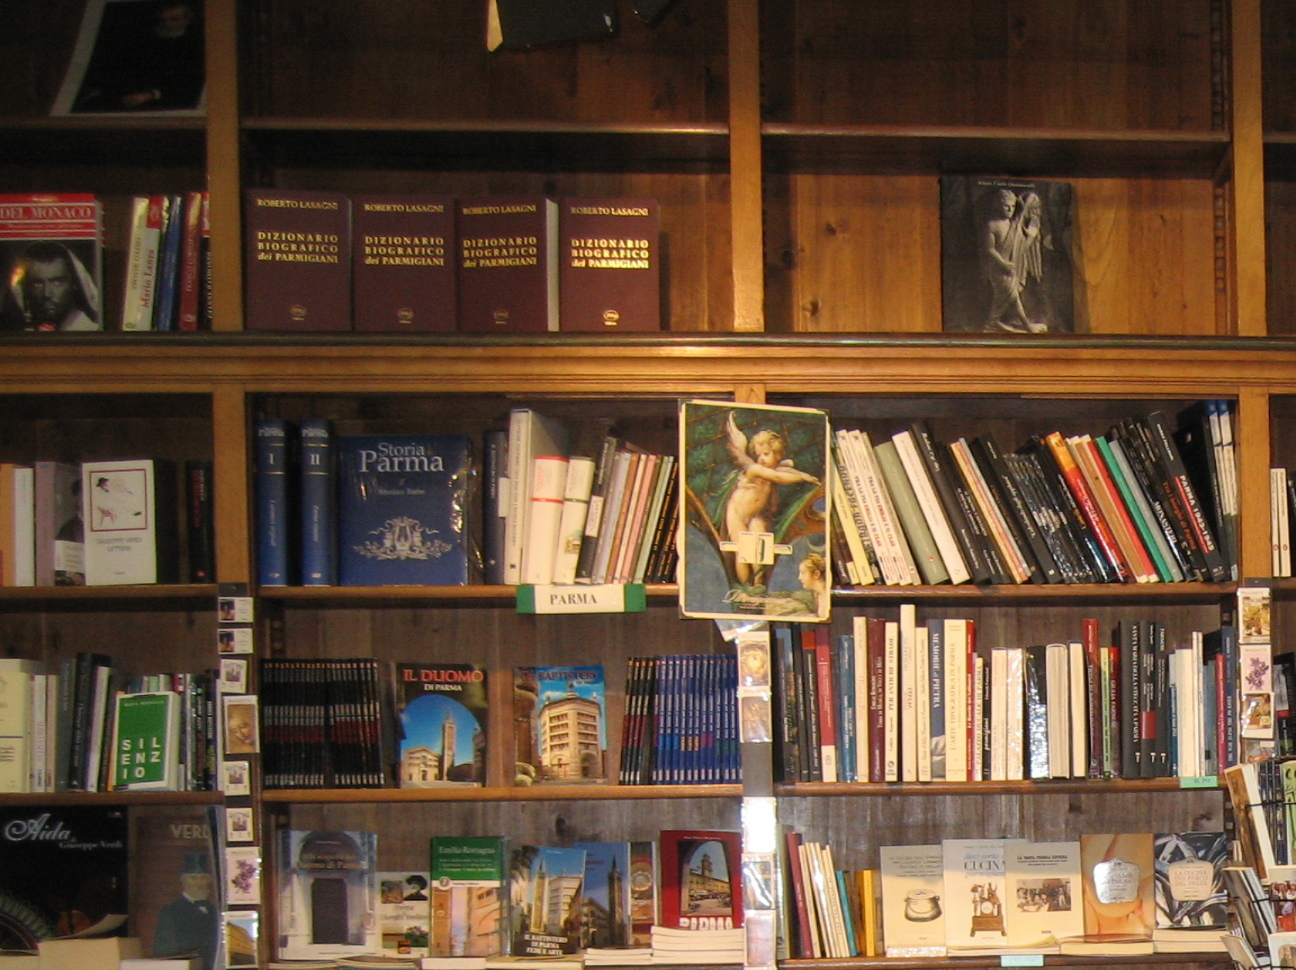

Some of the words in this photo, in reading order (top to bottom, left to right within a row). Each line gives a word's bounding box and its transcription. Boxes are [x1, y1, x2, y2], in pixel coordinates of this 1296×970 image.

[258, 199, 298, 209] ROBERTO
[299, 201, 338, 210] LASAGNI
[364, 204, 404, 212] ROBERTO
[406, 205, 444, 213] LASAGNI
[463, 206, 500, 215] ROBERTO
[501, 205, 536, 213] LASAGNI
[1, 208, 24, 219] DEL
[32, 207, 91, 219] MONACO
[571, 207, 610, 215] ROBERTO
[611, 208, 649, 216] LASAGNI
[258, 231, 338, 243] DIZIONARIO
[365, 236, 444, 245] DIZIONARIO
[463, 237, 537, 248] DIZIONARIO
[258, 243, 338, 253] BIOGRAFICO
[571, 239, 649, 248] DIZIONARIO
[365, 246, 444, 256] BIOGRAFICO
[463, 247, 537, 258] BIOGRAFICO
[571, 249, 649, 258] BIOGRAFICO
[258, 252, 272, 261] dei
[275, 253, 338, 264] PARMIGIANI
[365, 257, 379, 265] dei
[382, 257, 444, 266] PARMIGIANI
[463, 259, 477, 268] dei
[479, 257, 537, 267] PARMIGIANI
[571, 259, 586, 268] dei
[588, 260, 649, 269] PARMIGIANI
[378, 442, 425, 457] Storia
[359, 450, 444, 472] Parma
[1180, 475, 1195, 506] PARMA
[550, 594, 597, 605] PARMA
[403, 669, 417, 682] IL
[421, 669, 484, 683] DUOMO
[435, 684, 462, 692] PARMA
[5, 813, 72, 841] Aida
